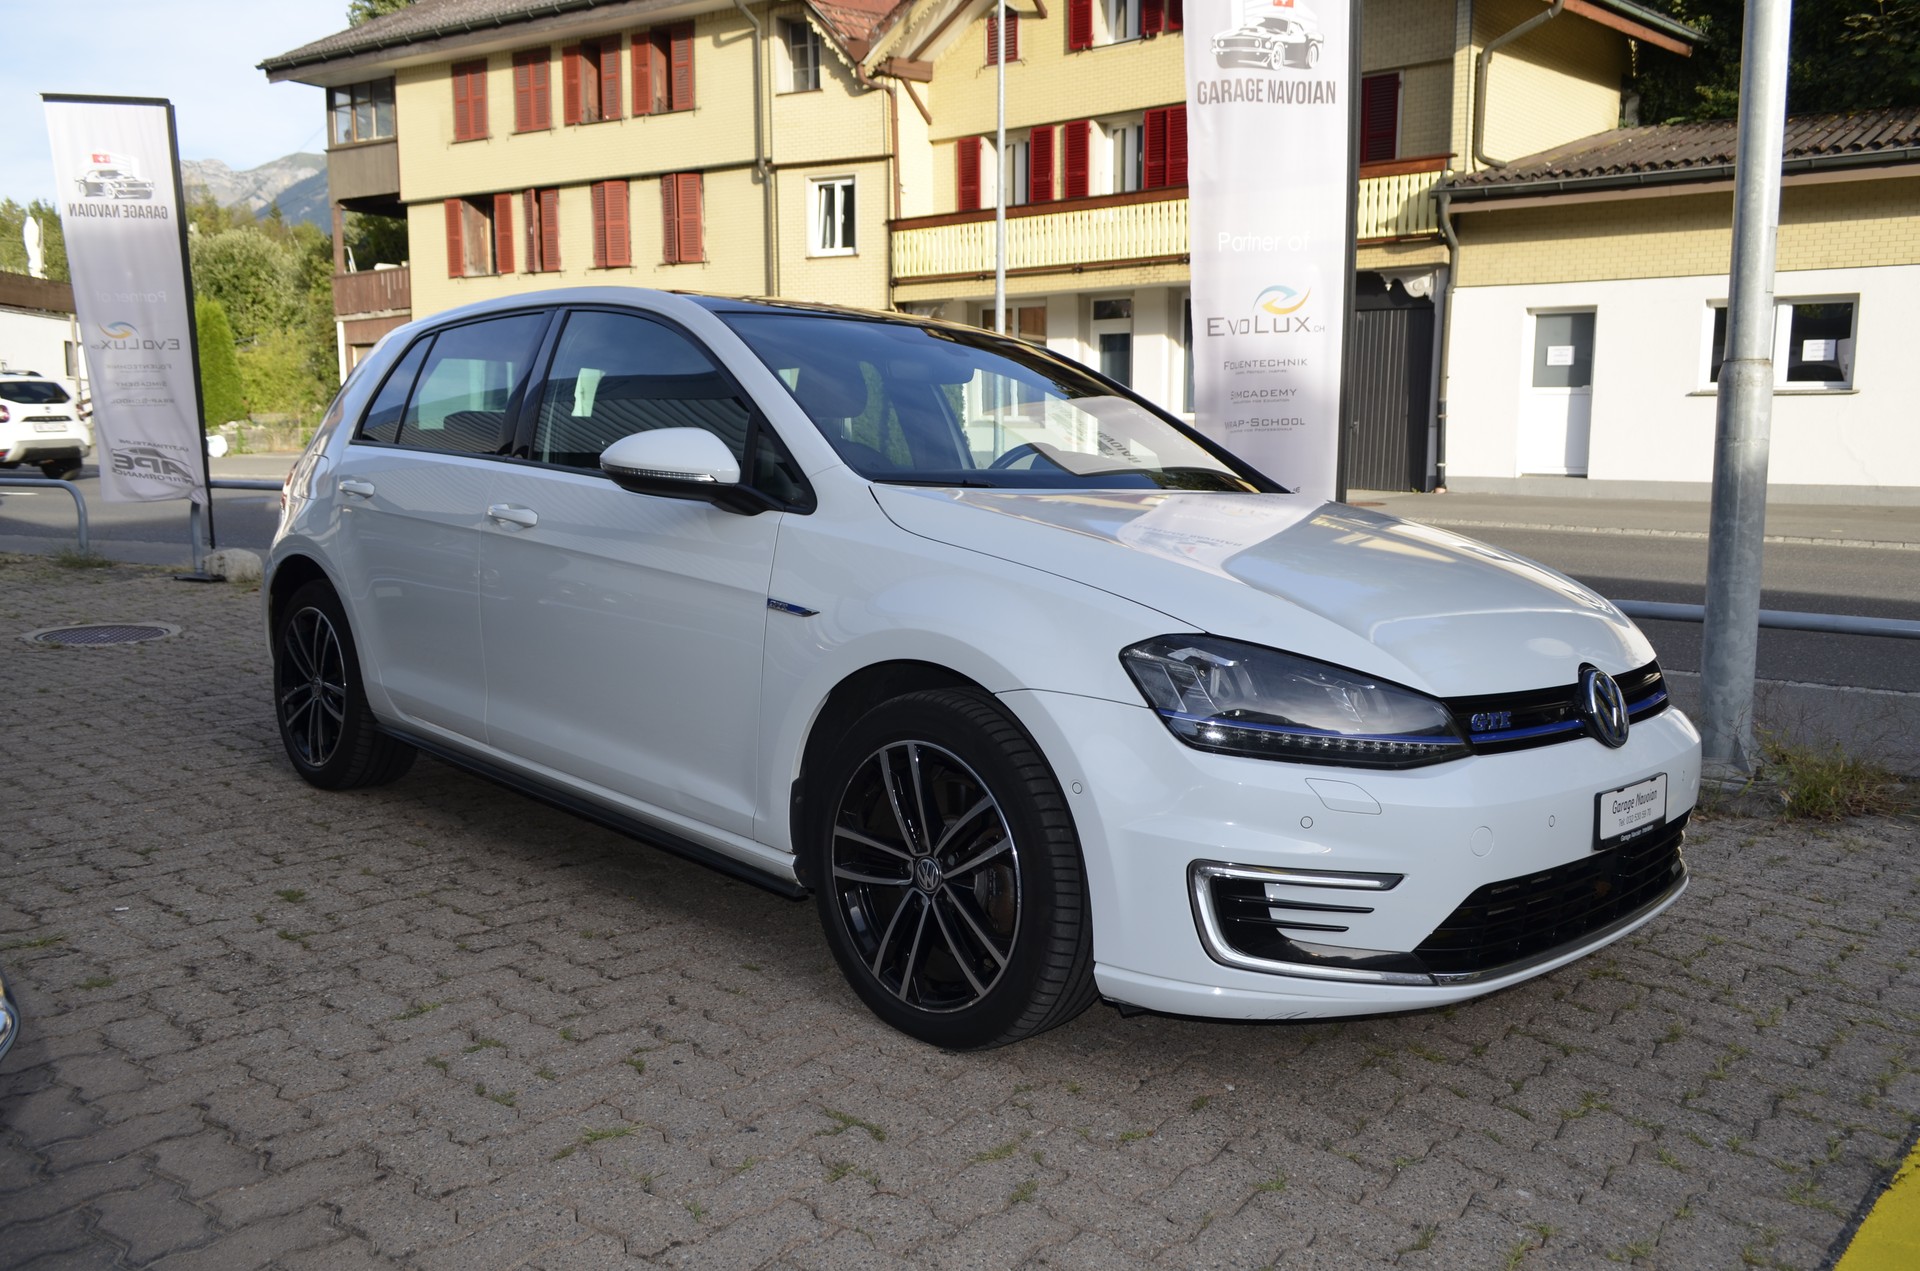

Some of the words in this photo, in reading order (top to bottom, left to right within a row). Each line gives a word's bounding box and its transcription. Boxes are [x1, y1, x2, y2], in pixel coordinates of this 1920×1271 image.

[1197, 78, 1263, 105] GARAGE
[1267, 79, 1336, 104] NAVOIAN
[1218, 233, 1282, 253] Partner
[1288, 230, 1311, 252] of
[1470, 711, 1512, 732] GTE
[1612, 799, 1635, 814] Garage
[1635, 788, 1657, 807] Navoian
